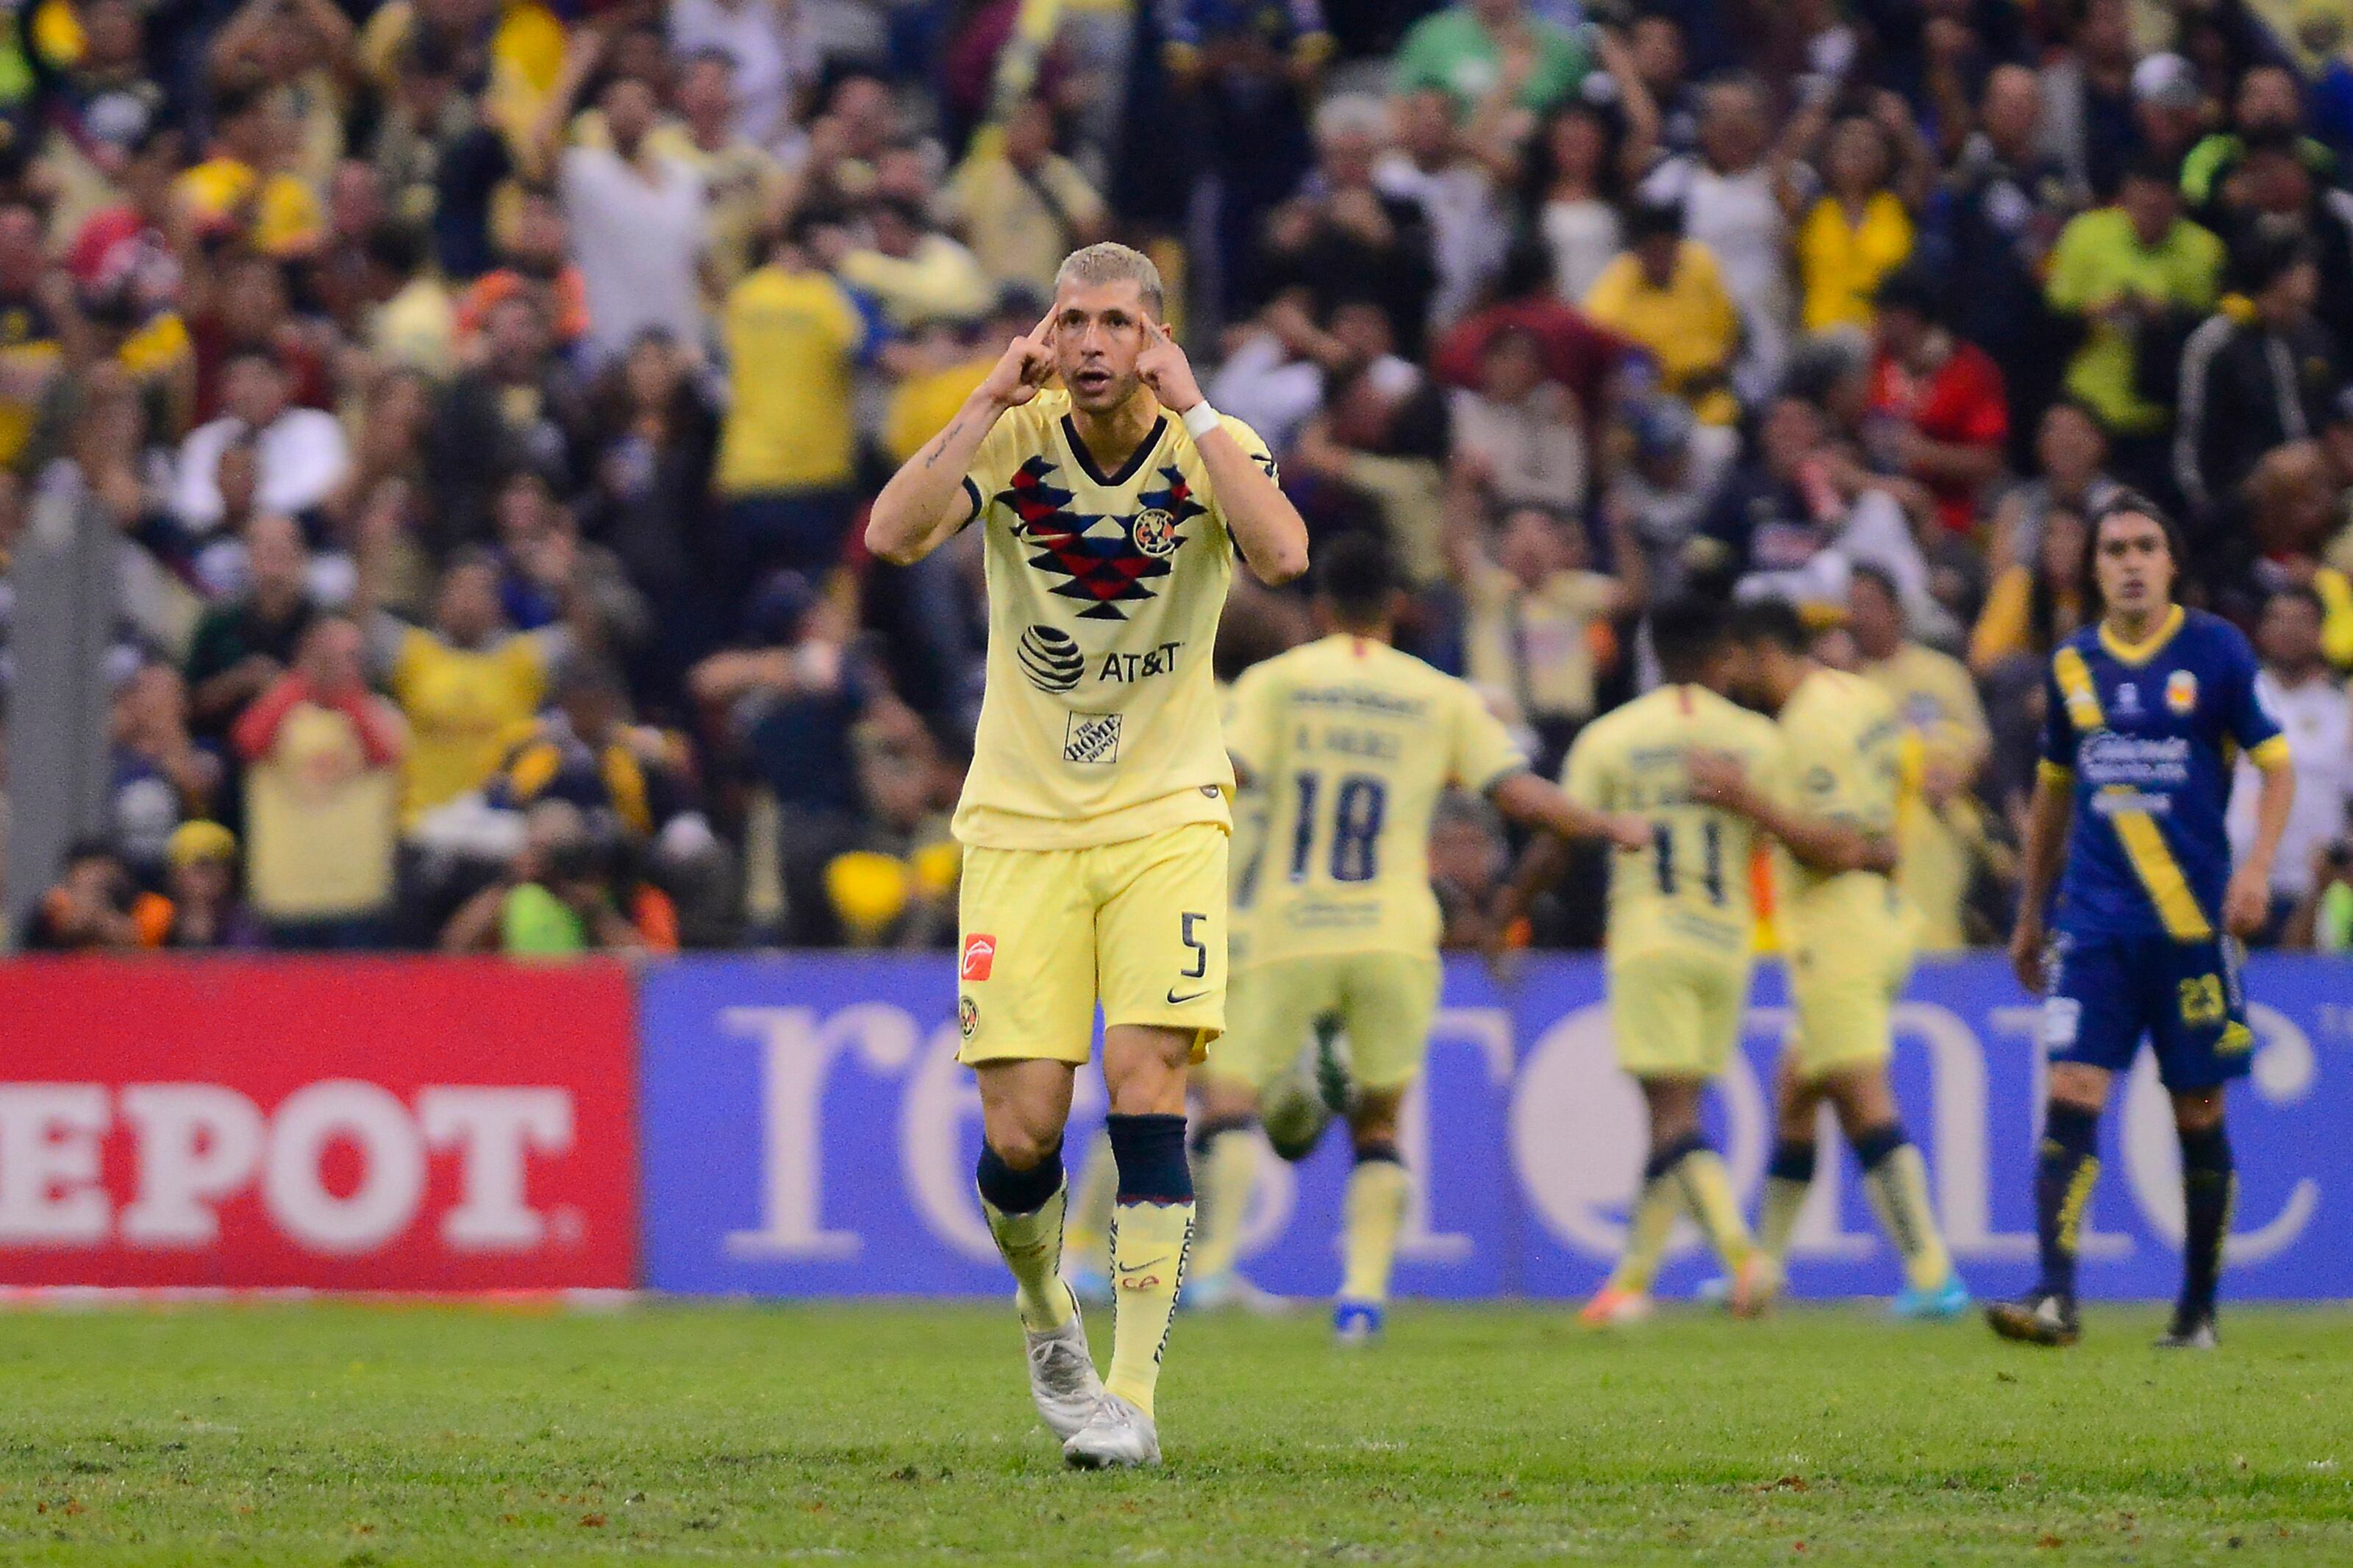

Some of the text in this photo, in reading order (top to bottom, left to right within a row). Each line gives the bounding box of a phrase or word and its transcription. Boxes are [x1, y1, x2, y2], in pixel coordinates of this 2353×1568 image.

[1099, 642, 1181, 683] AT&T
[1066, 715, 1119, 762] HOME
[1288, 770, 1390, 884] 18
[1650, 820, 1727, 909] 11
[1180, 911, 1207, 979] 5
[2177, 973, 2224, 1026] 23
